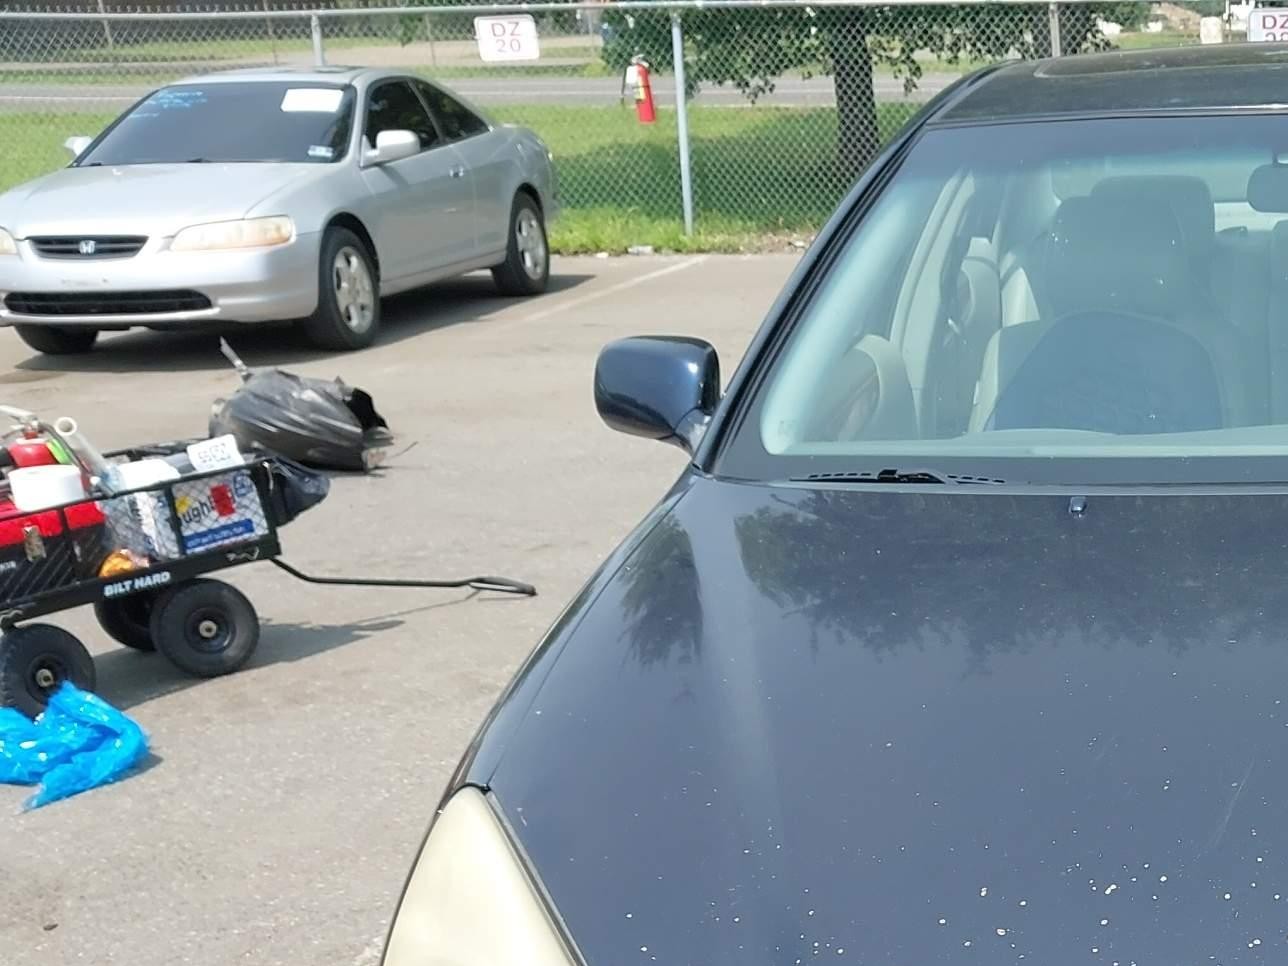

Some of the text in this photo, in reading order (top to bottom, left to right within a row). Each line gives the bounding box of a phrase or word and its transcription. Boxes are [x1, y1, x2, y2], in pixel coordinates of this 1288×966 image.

[491, 21, 522, 37] DZ
[495, 38, 521, 53] 20
[104, 571, 171, 597] BILT HARD
